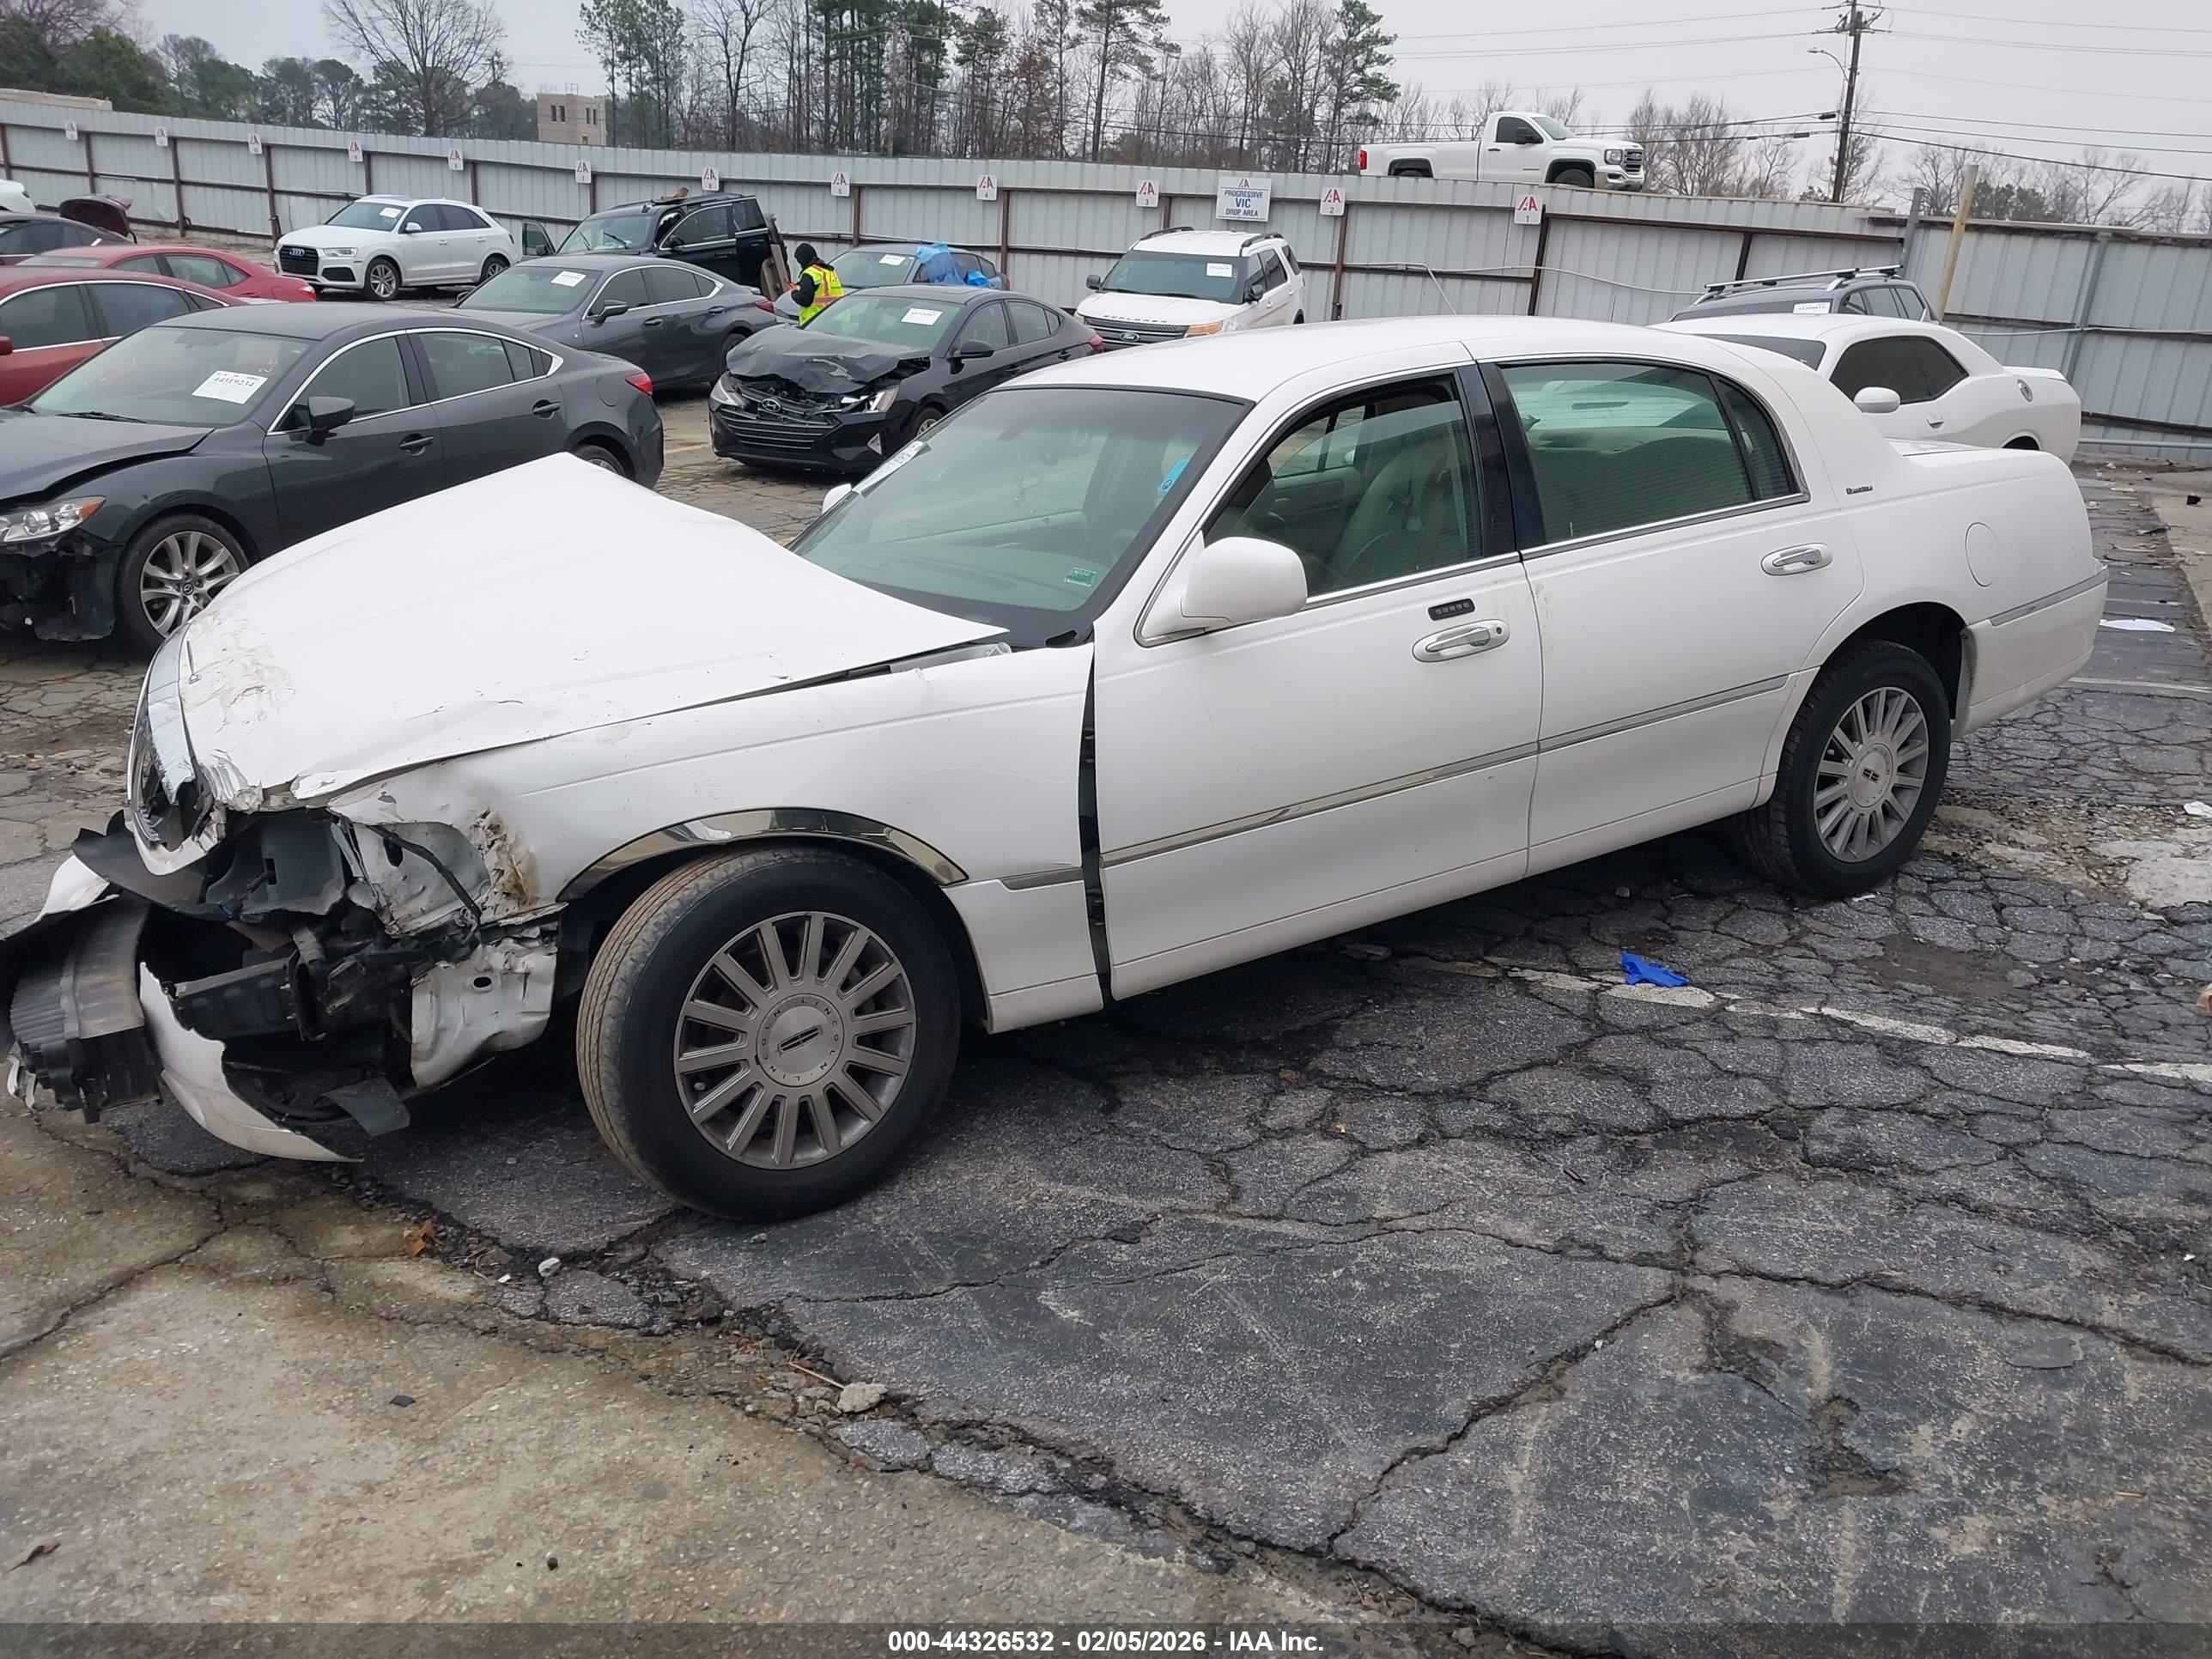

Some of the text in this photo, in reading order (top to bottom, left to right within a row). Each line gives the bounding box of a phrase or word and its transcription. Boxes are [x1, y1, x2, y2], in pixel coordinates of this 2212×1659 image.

[1224, 189, 1263, 198] PROGRESSIVE
[1236, 198, 1251, 209] VIC
[1243, 209, 1259, 217] AREA
